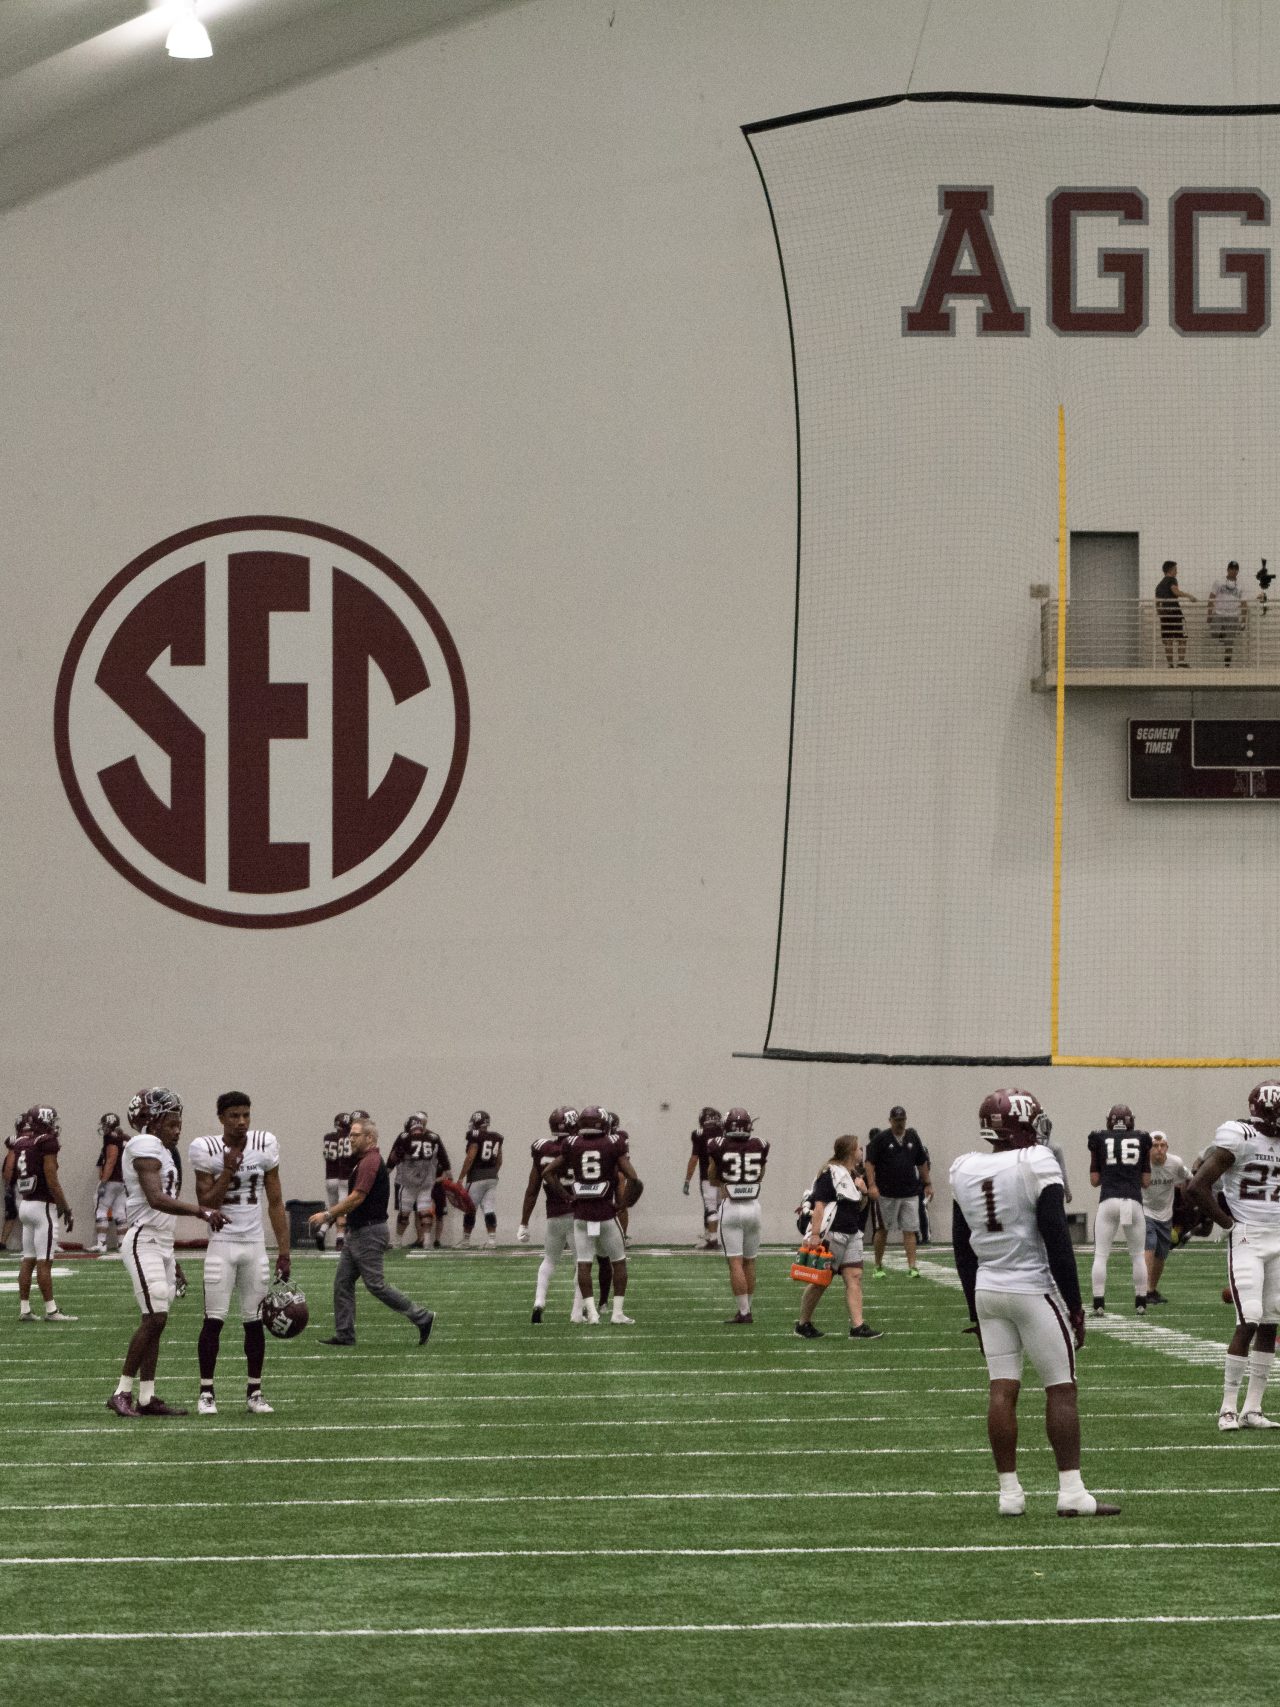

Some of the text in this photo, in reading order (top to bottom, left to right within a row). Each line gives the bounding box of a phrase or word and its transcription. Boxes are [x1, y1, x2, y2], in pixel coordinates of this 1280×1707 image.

[95, 551, 432, 894] SEC
[1136, 727, 1180, 740] SEGMENT
[1144, 741, 1173, 754] TIMER
[581, 1150, 601, 1180] 6
[1105, 1137, 1140, 1165] 16
[1254, 1153, 1274, 1163] TEXAS
[722, 1152, 762, 1183] 35
[981, 1176, 1004, 1232] 1
